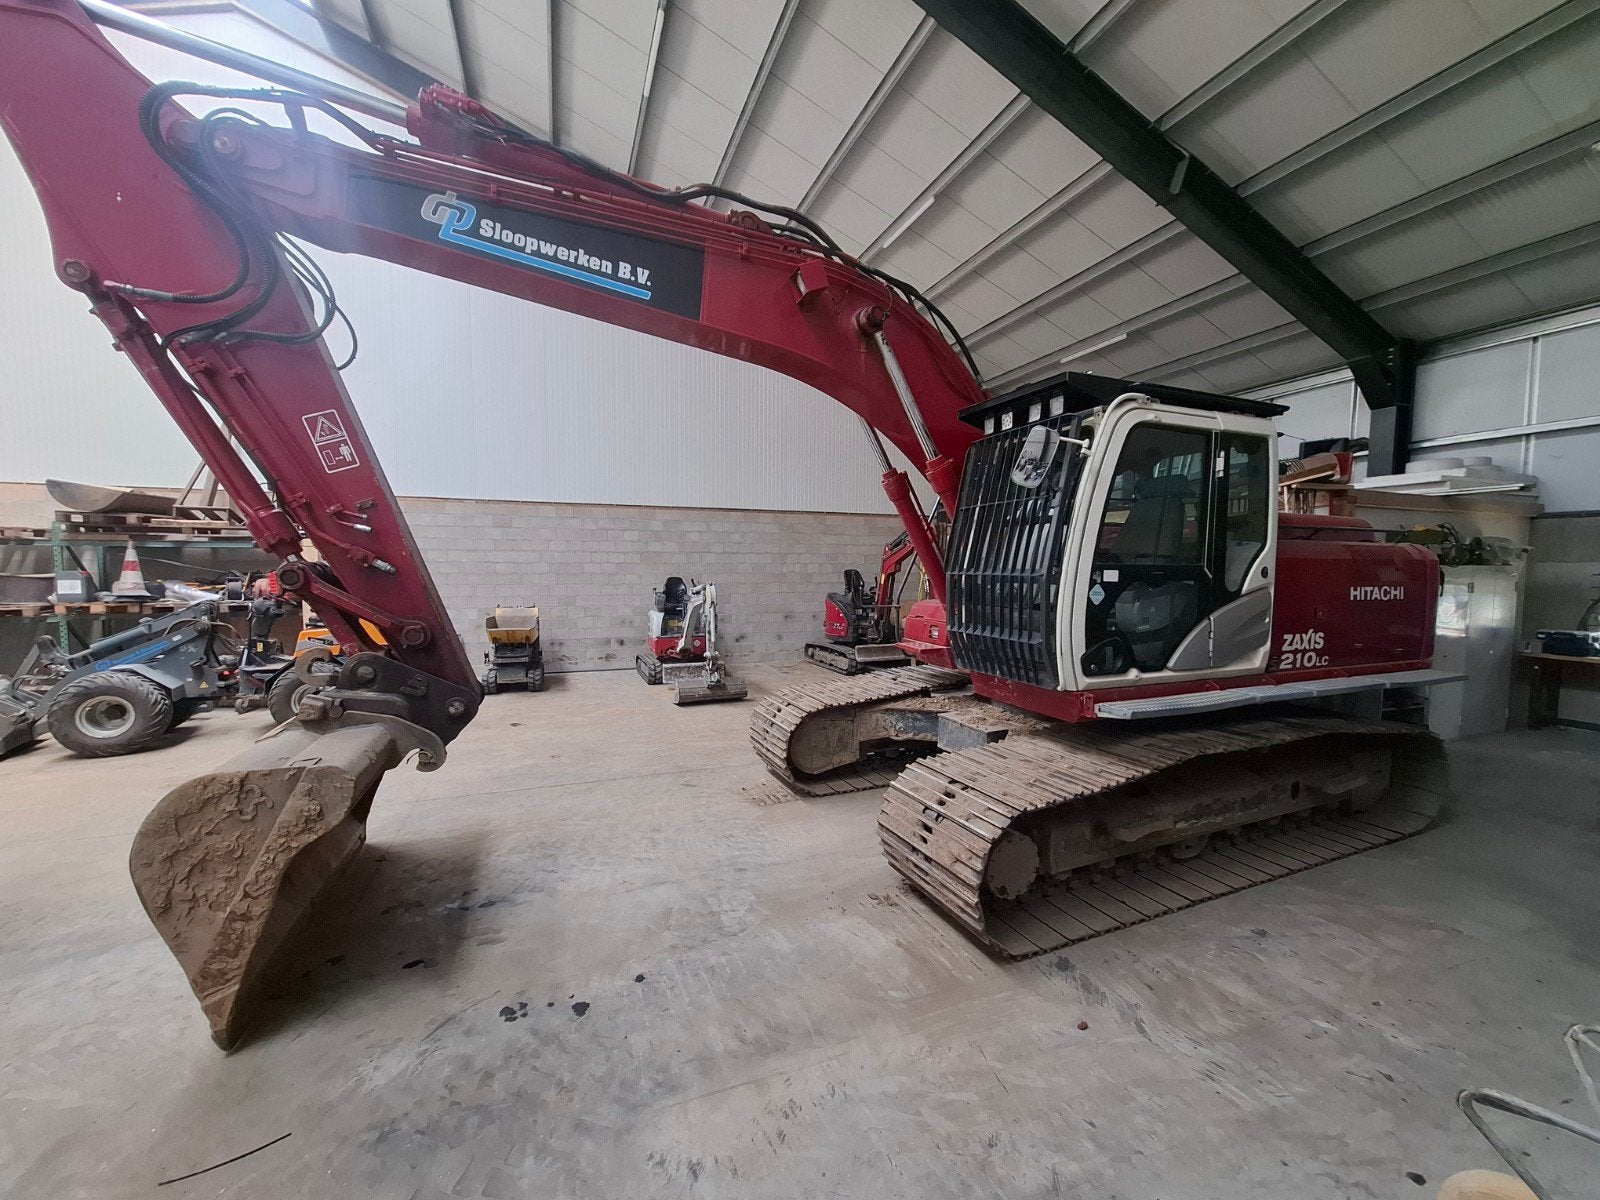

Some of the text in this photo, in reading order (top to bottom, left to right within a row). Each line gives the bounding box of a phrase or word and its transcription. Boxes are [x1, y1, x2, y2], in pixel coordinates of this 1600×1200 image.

[479, 218, 613, 275] Sloopwerken
[617, 261, 651, 286] B.V.
[1350, 585, 1404, 600] HITACHI
[1281, 628, 1325, 651] ZAXIS
